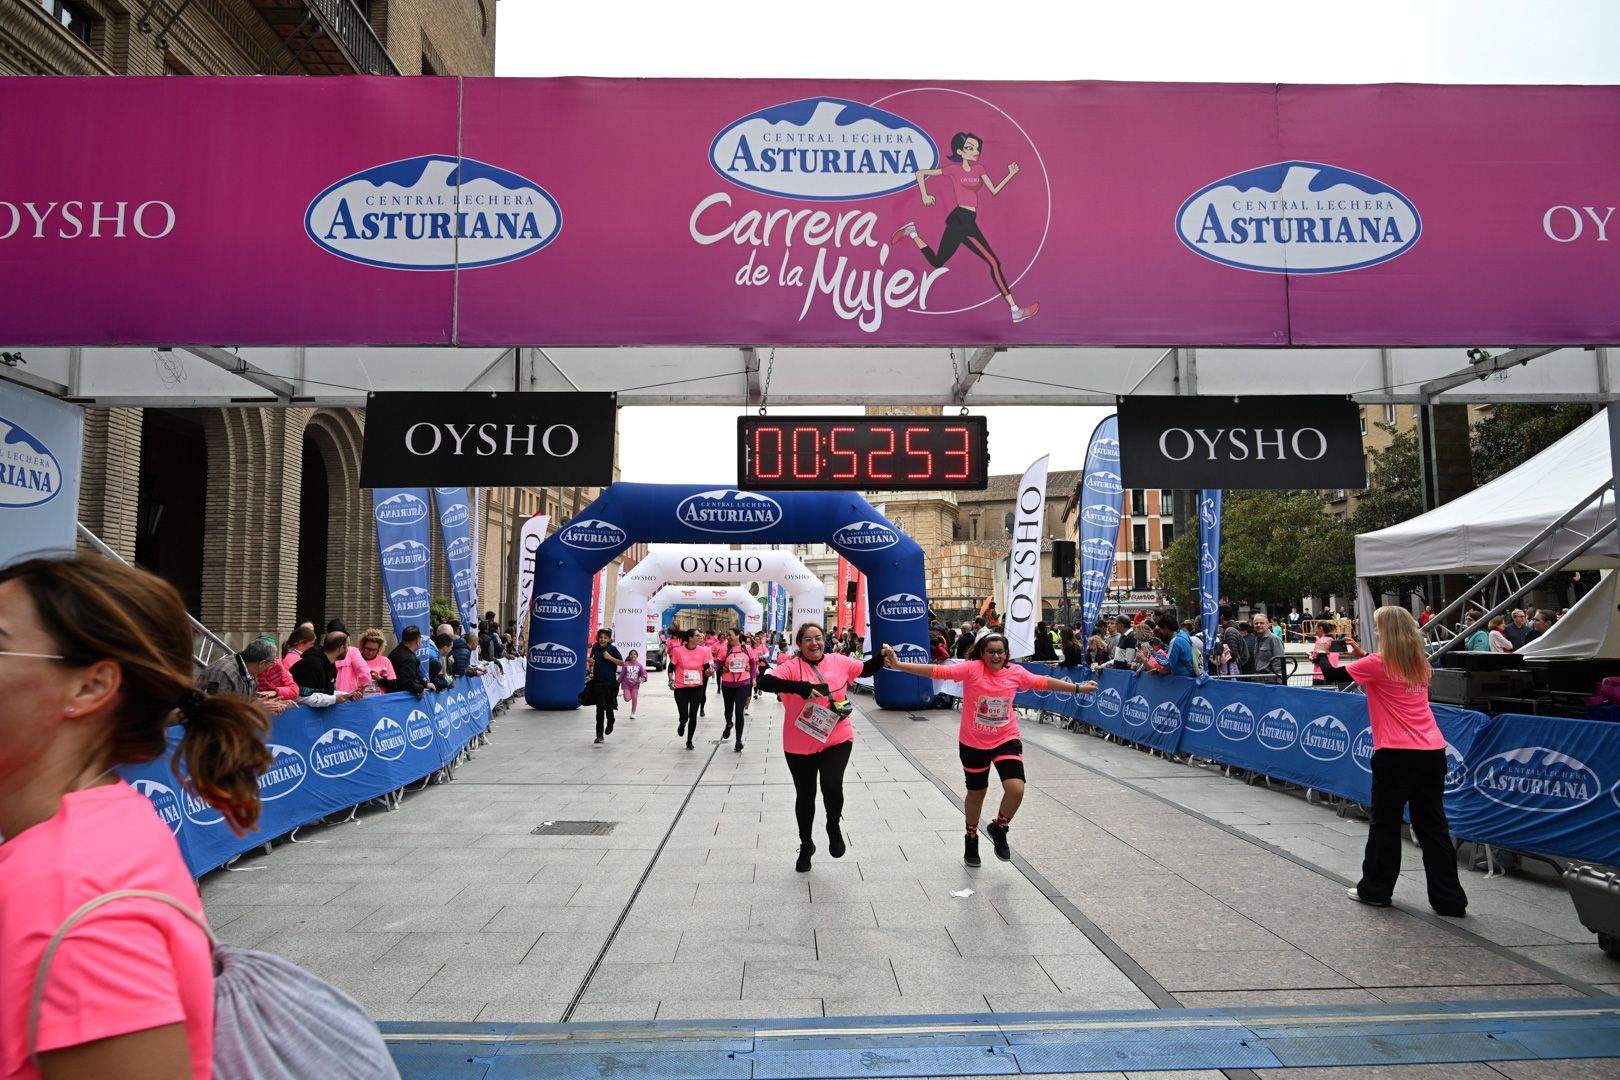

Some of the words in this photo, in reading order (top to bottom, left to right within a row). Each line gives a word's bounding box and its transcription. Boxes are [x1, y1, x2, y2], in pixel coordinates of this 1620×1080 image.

[763, 132, 834, 143] CENTRAL
[842, 133, 914, 144] LECHERA
[728, 134, 919, 175] ASTURIANA
[365, 195, 445, 206] CENTRAL
[453, 195, 534, 206] LECHERA
[1233, 200, 1309, 211] CENTRAL
[1317, 199, 1394, 210] LECHERA
[324, 197, 542, 240] ASTURIANA
[689, 192, 878, 248] Carrera
[1196, 202, 1403, 244] ASTURIANA
[735, 249, 771, 287] de
[778, 250, 805, 287] la
[798, 244, 950, 333] Mujer
[405, 422, 579, 457] OYSHO
[1159, 427, 1328, 461] OYSHO
[685, 502, 775, 522] ASTURIANA
[563, 530, 621, 543] ASTURIANA
[839, 533, 895, 545] ASTURIANA
[680, 556, 762, 574] OYSHO
[1010, 486, 1042, 623] OYSHO
[533, 601, 578, 614] ASTURIANA
[880, 604, 924, 616] ASTURIANA
[529, 651, 573, 664] ASTURIANA
[1259, 721, 1294, 742] ASTURIANA
[1302, 728, 1345, 753] ASTURIANA
[316, 746, 365, 771] ASTURIANA
[1478, 766, 1589, 801] ASTURIANA
